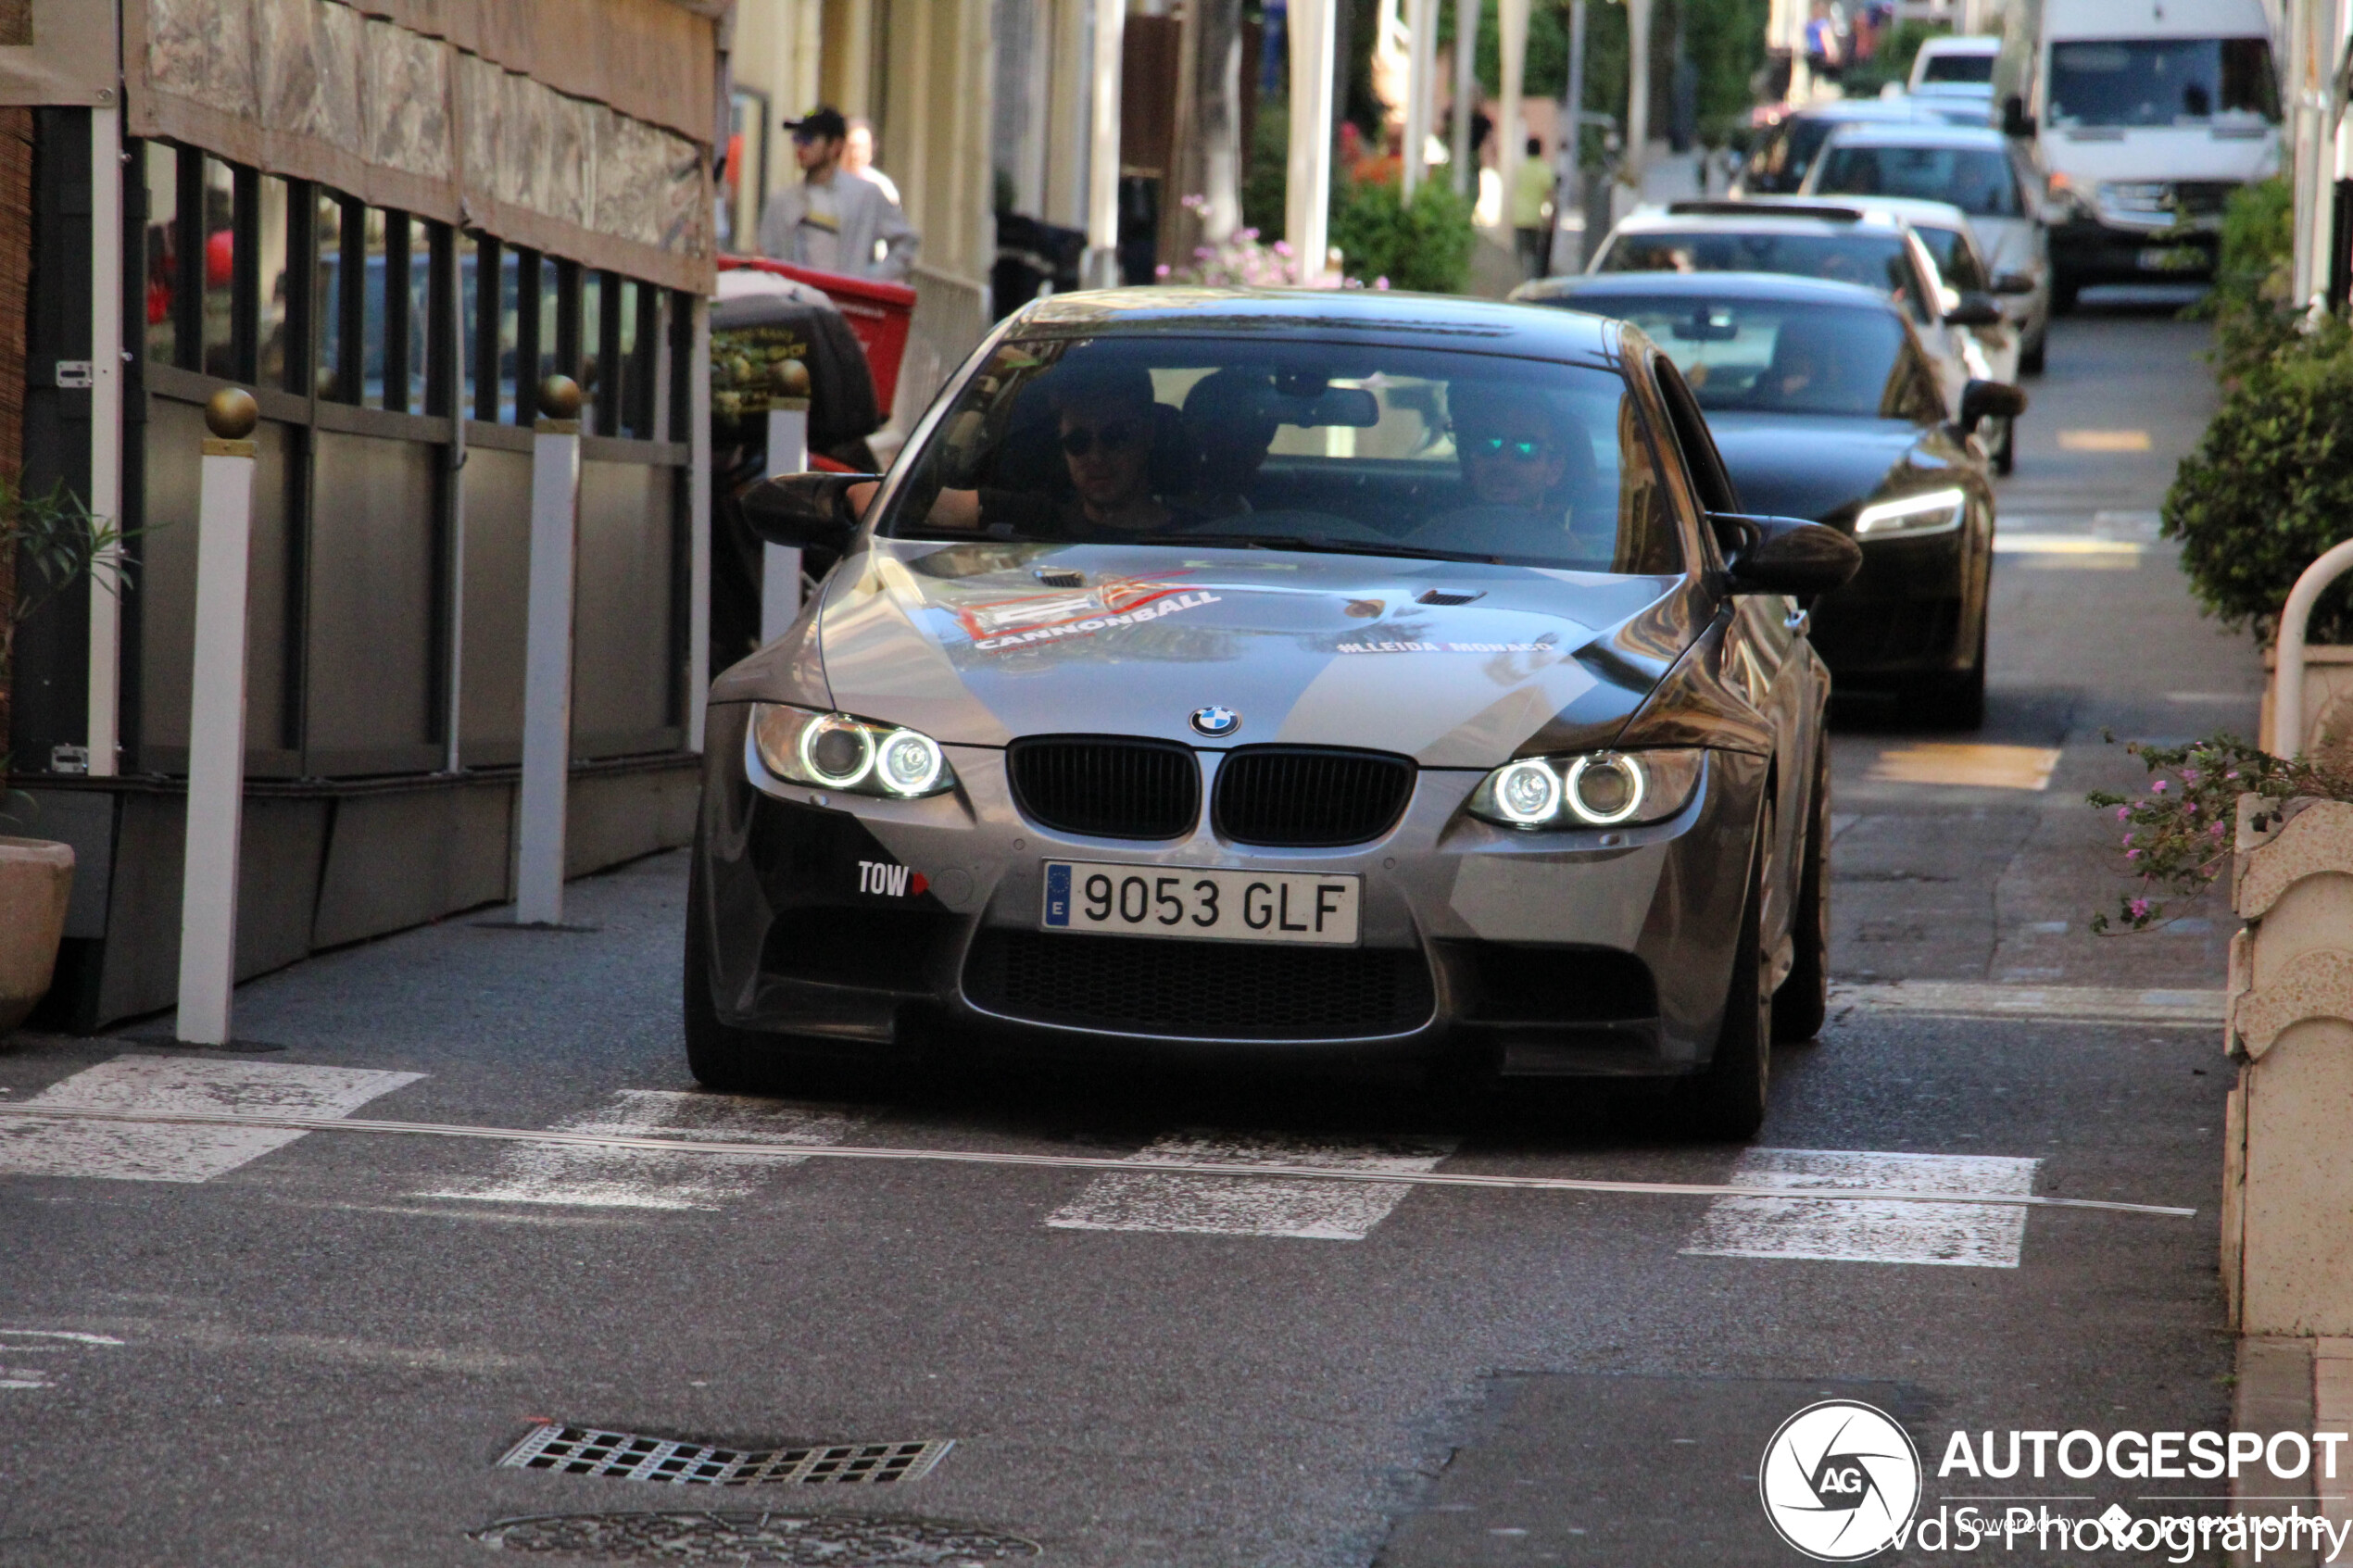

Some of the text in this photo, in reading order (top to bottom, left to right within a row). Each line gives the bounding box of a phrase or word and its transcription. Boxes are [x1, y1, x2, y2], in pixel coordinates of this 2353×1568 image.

[975, 591, 1222, 650] CANNONBALL
[858, 860, 910, 897] TOW
[1051, 901, 1064, 915] E
[1084, 873, 1346, 933] 9053 GLF
